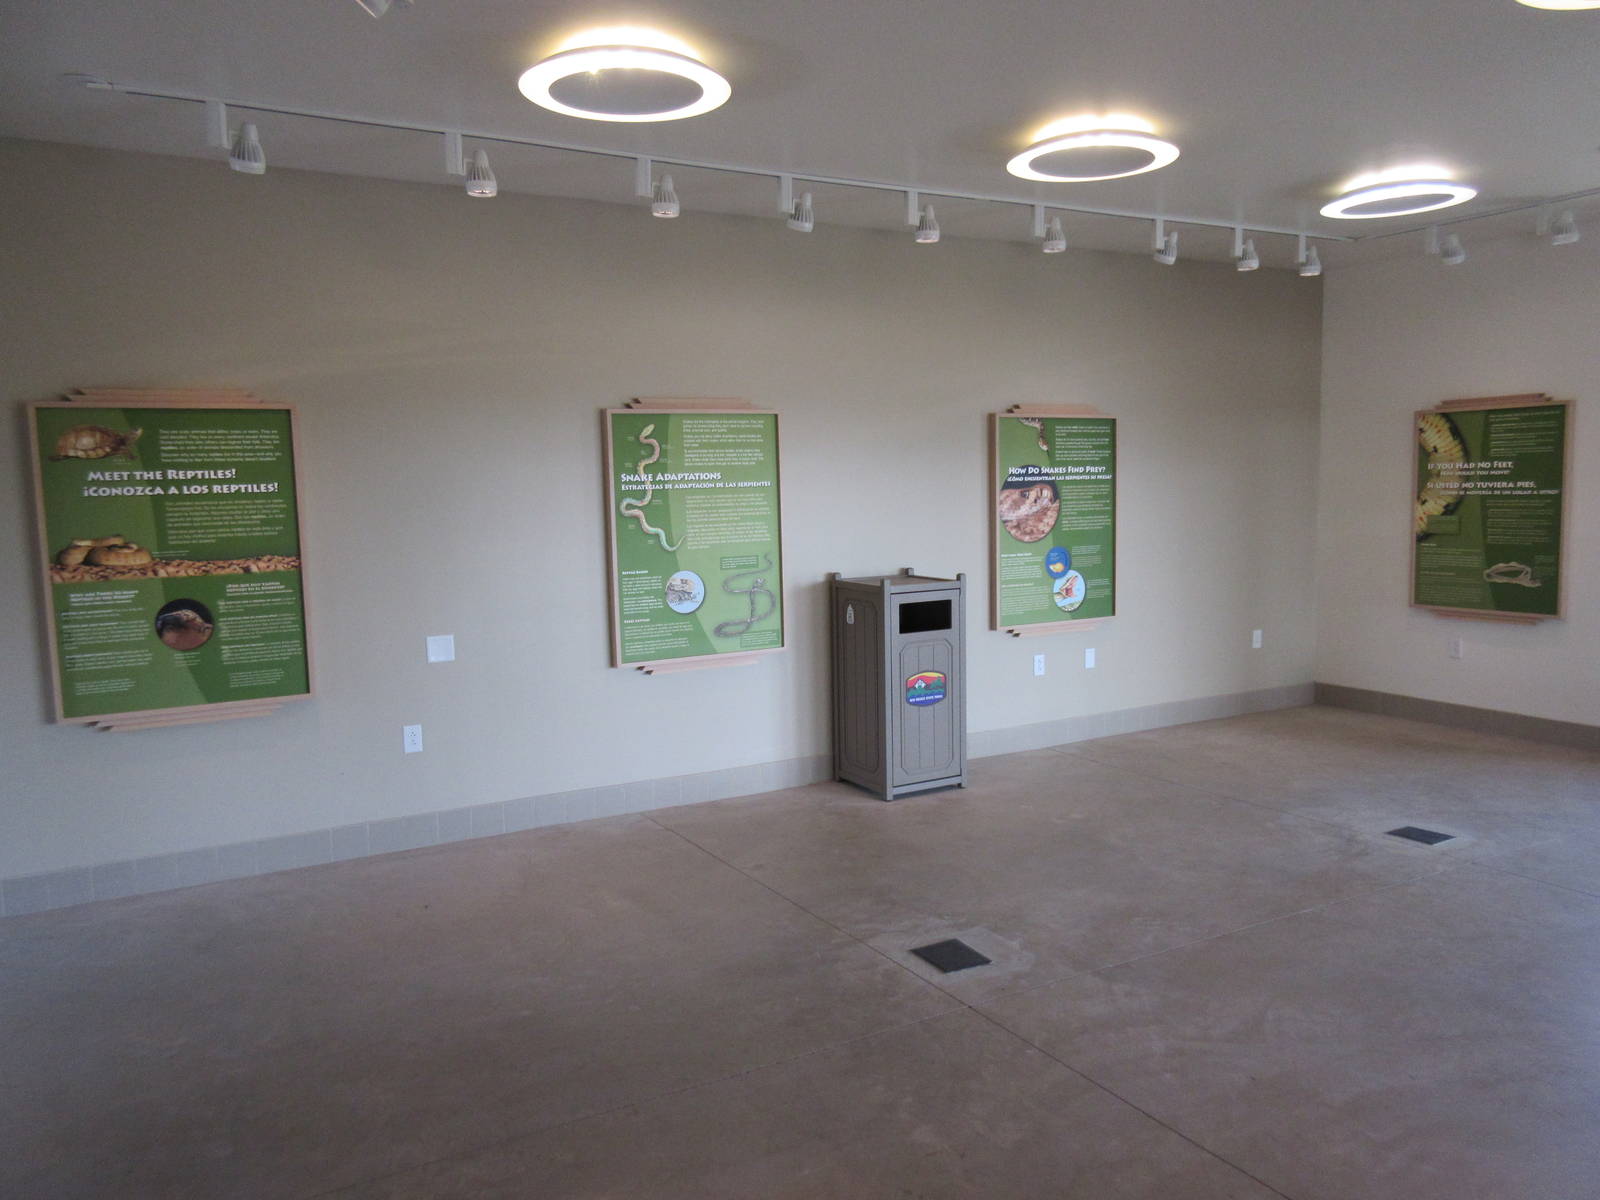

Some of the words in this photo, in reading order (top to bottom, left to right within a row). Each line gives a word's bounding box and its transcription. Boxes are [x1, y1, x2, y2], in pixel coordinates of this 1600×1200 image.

[88, 470, 130, 482] MEET
[134, 470, 163, 480] THE
[167, 468, 236, 480] REPTILES!
[1041, 466, 1066, 474] SNAKES
[621, 473, 654, 482] SNAKE
[656, 472, 722, 481] ADAPTATIONS
[84, 486, 164, 497] ¡CONOZCA
[168, 486, 179, 495] A
[183, 484, 209, 494] LOS
[212, 482, 278, 494] REPTILES!
